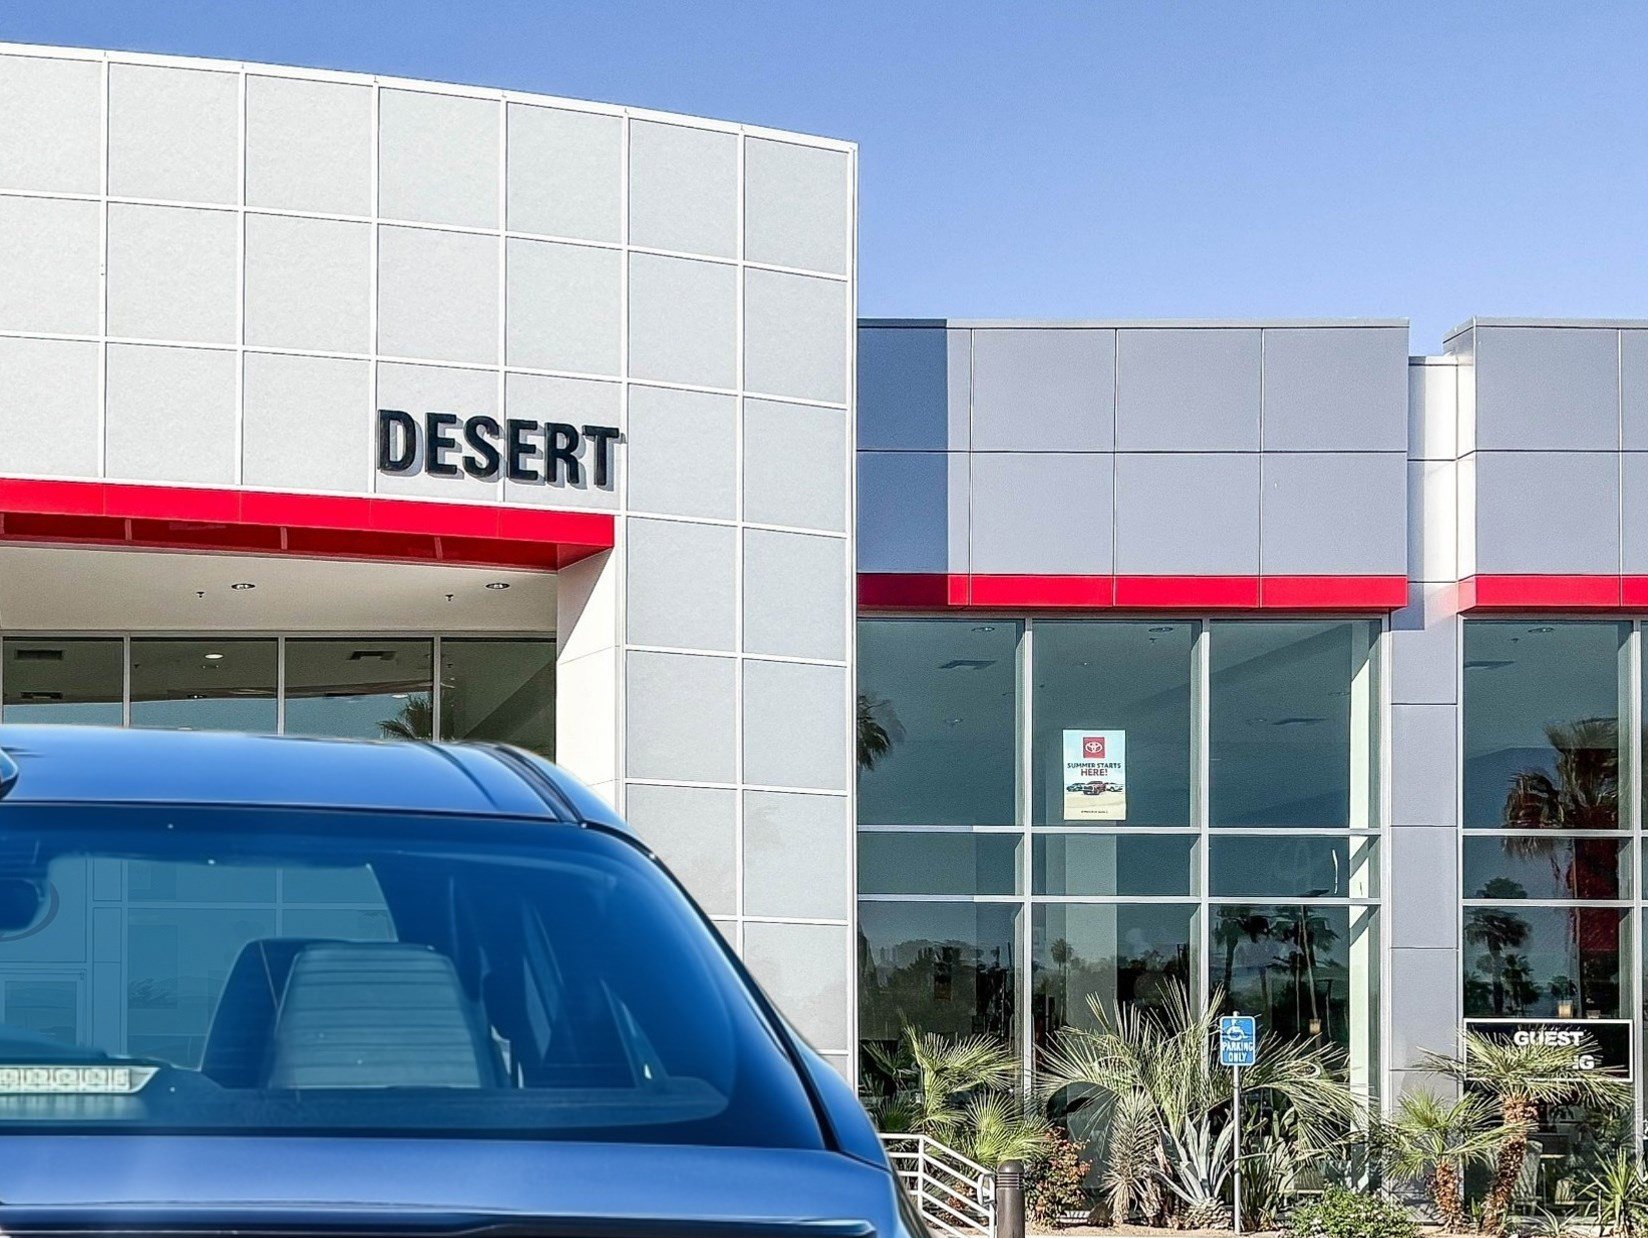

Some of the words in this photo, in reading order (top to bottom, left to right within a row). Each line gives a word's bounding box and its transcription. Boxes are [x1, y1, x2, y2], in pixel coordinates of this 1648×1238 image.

[377, 409, 620, 486] DESERT
[1513, 1031, 1584, 1046] GUEST
[1222, 1041, 1253, 1052] PARKING
[1228, 1052, 1248, 1062] ONLY
